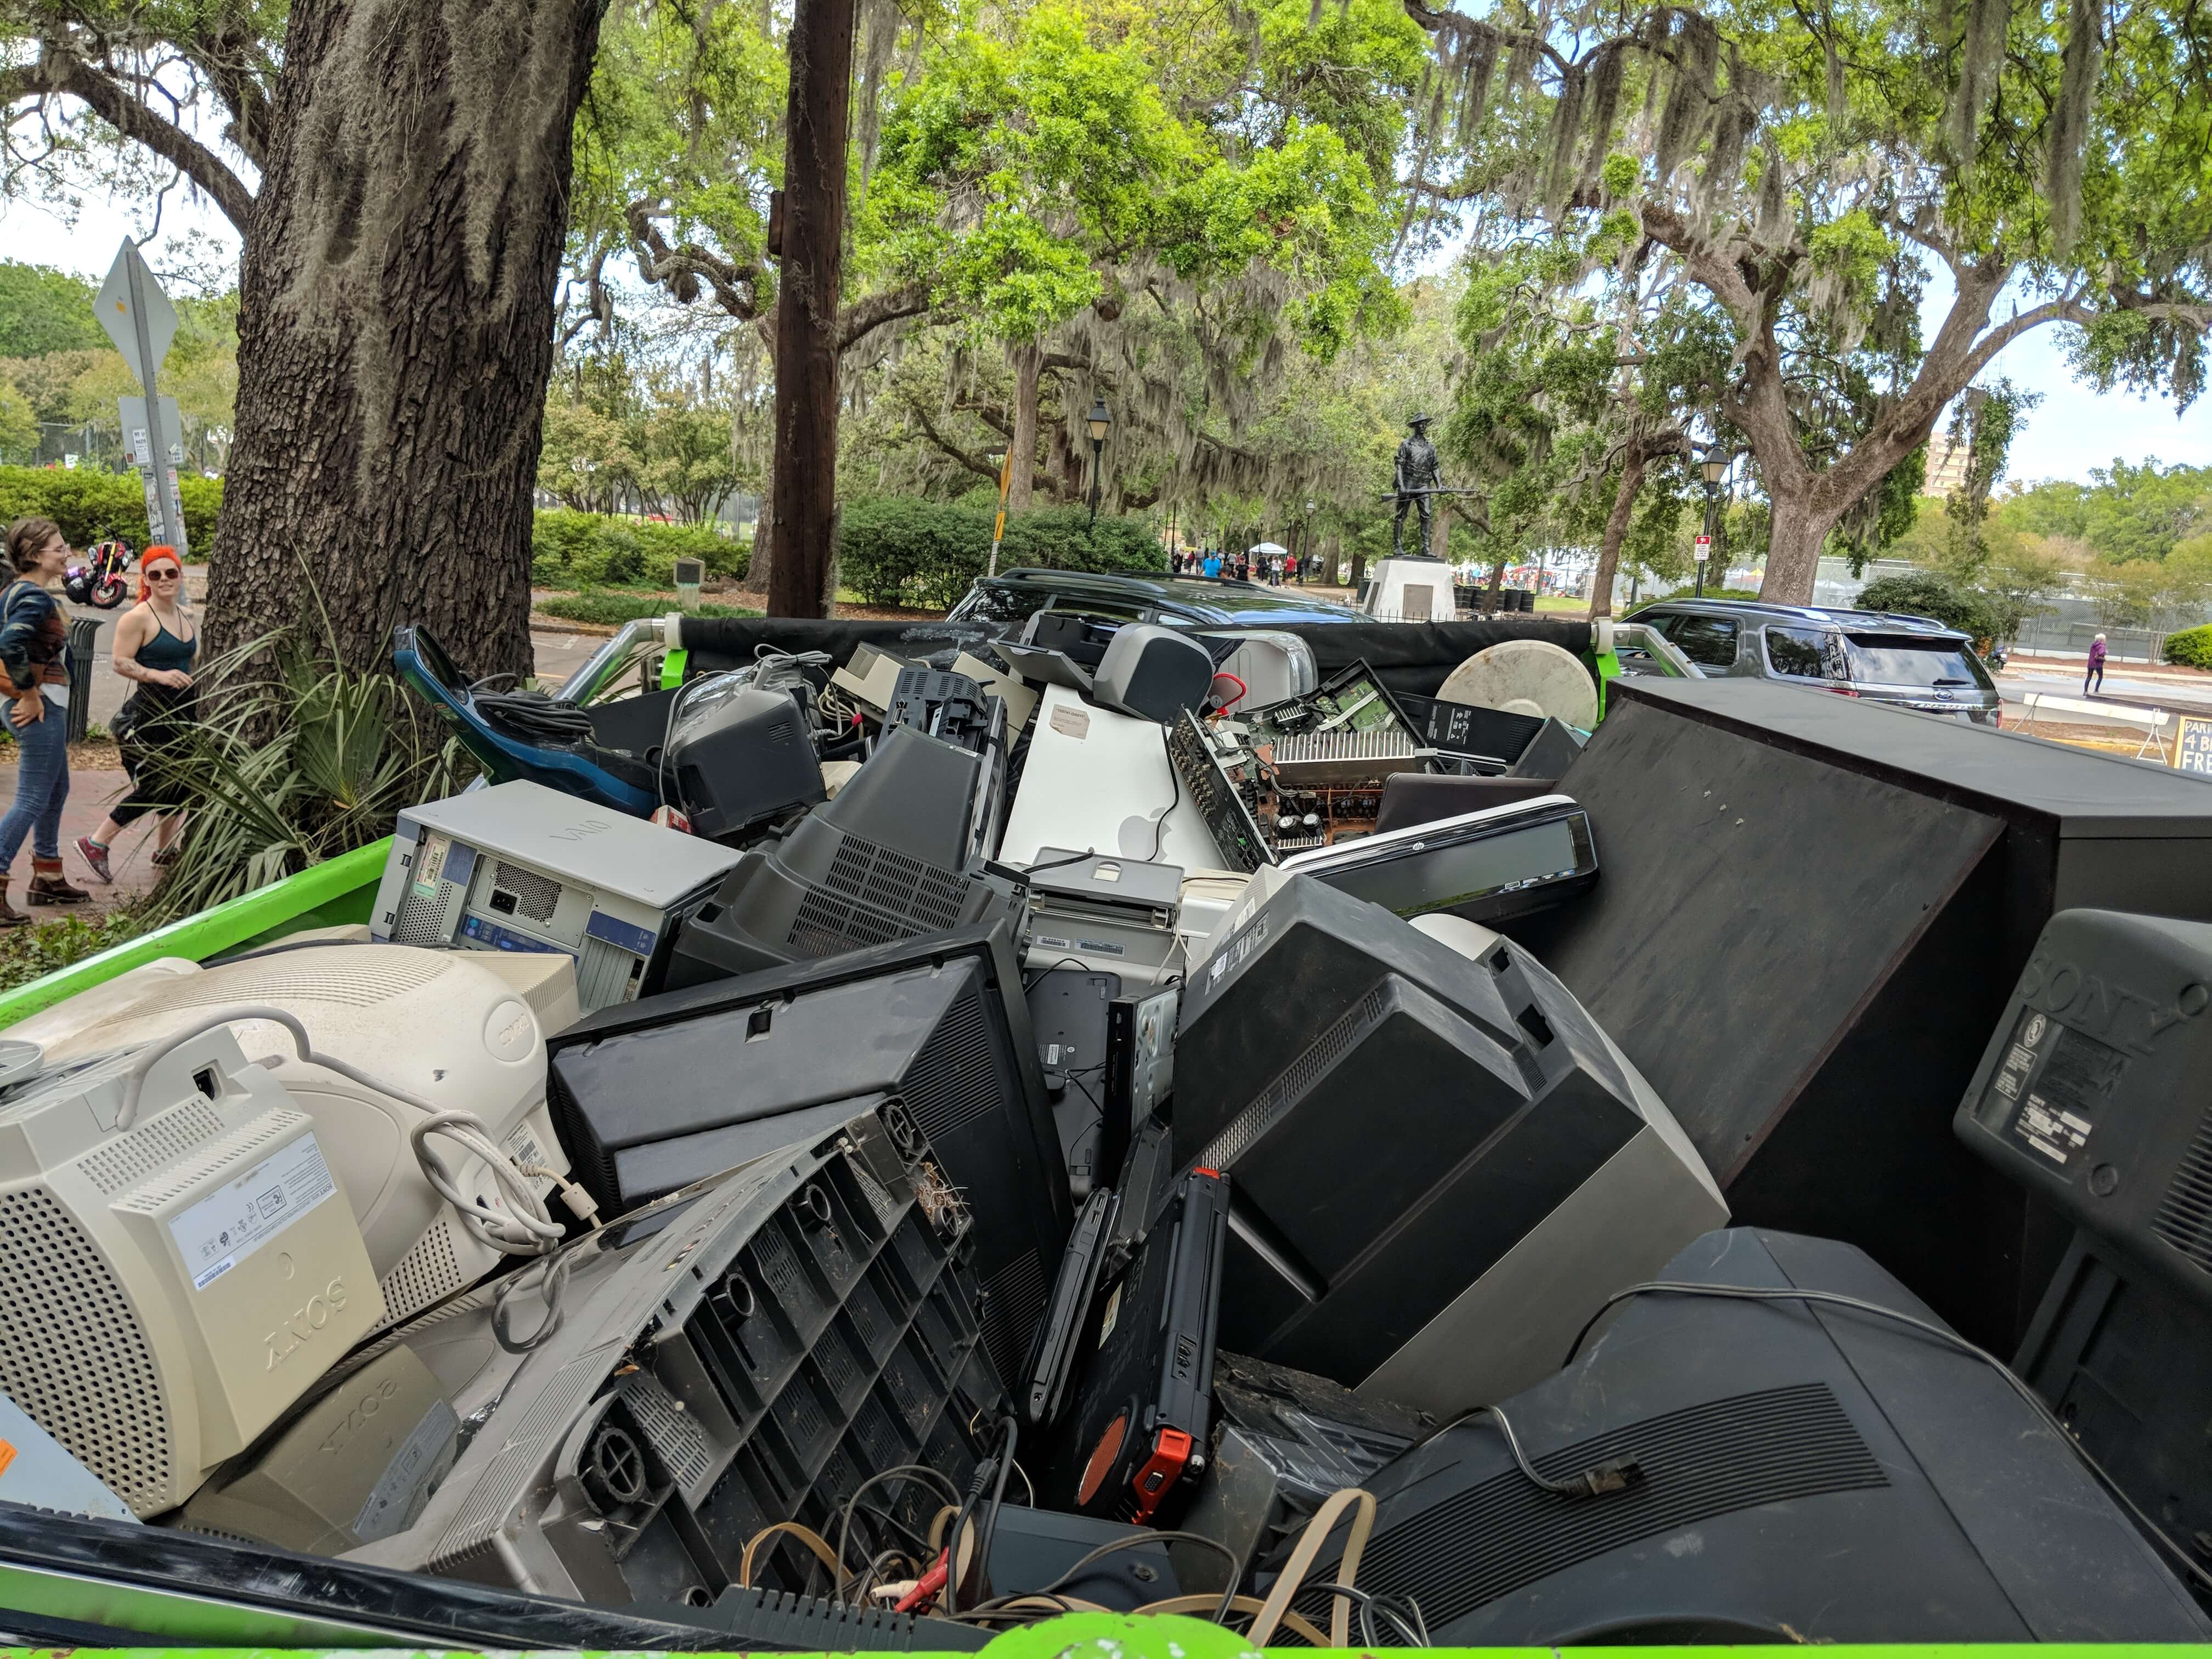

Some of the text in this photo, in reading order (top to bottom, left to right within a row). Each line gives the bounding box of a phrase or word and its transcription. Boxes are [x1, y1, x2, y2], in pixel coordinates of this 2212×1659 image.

[2185, 734, 2212, 752] 4 B
[549, 820, 612, 841] VAIO
[2017, 955, 2186, 1056] SONY
[320, 1184, 333, 1195] SONY
[264, 1275, 348, 1372] SONY
[318, 1375, 400, 1456] SONY
